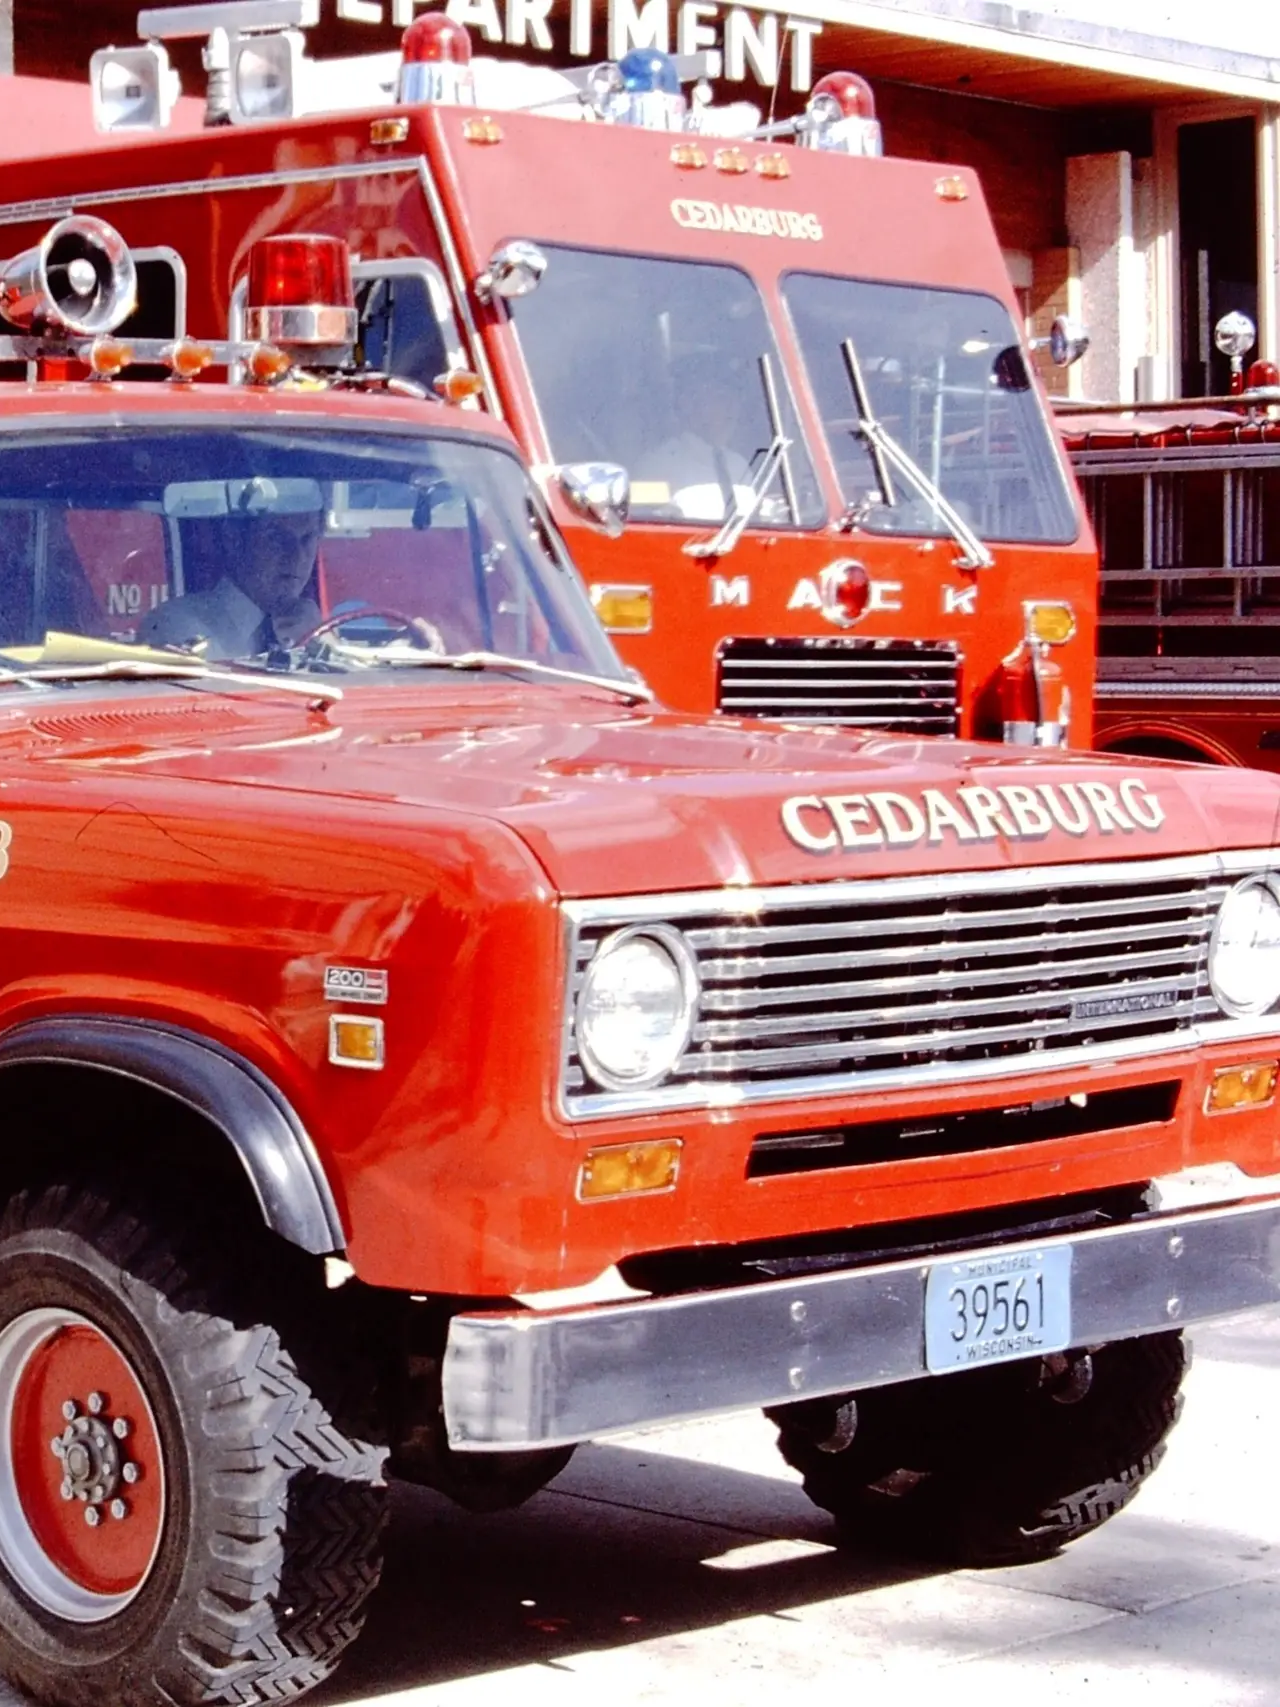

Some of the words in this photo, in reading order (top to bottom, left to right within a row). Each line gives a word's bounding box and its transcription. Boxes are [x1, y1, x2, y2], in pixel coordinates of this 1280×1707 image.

[670, 198, 824, 242] CEDARBURG
[780, 777, 1167, 854] CEDARBURG
[328, 968, 364, 988] 200
[968, 1256, 1033, 1277] MUNICIPAL
[948, 1272, 1044, 1342] 39561
[966, 1335, 1034, 1360] WISCONSIN
